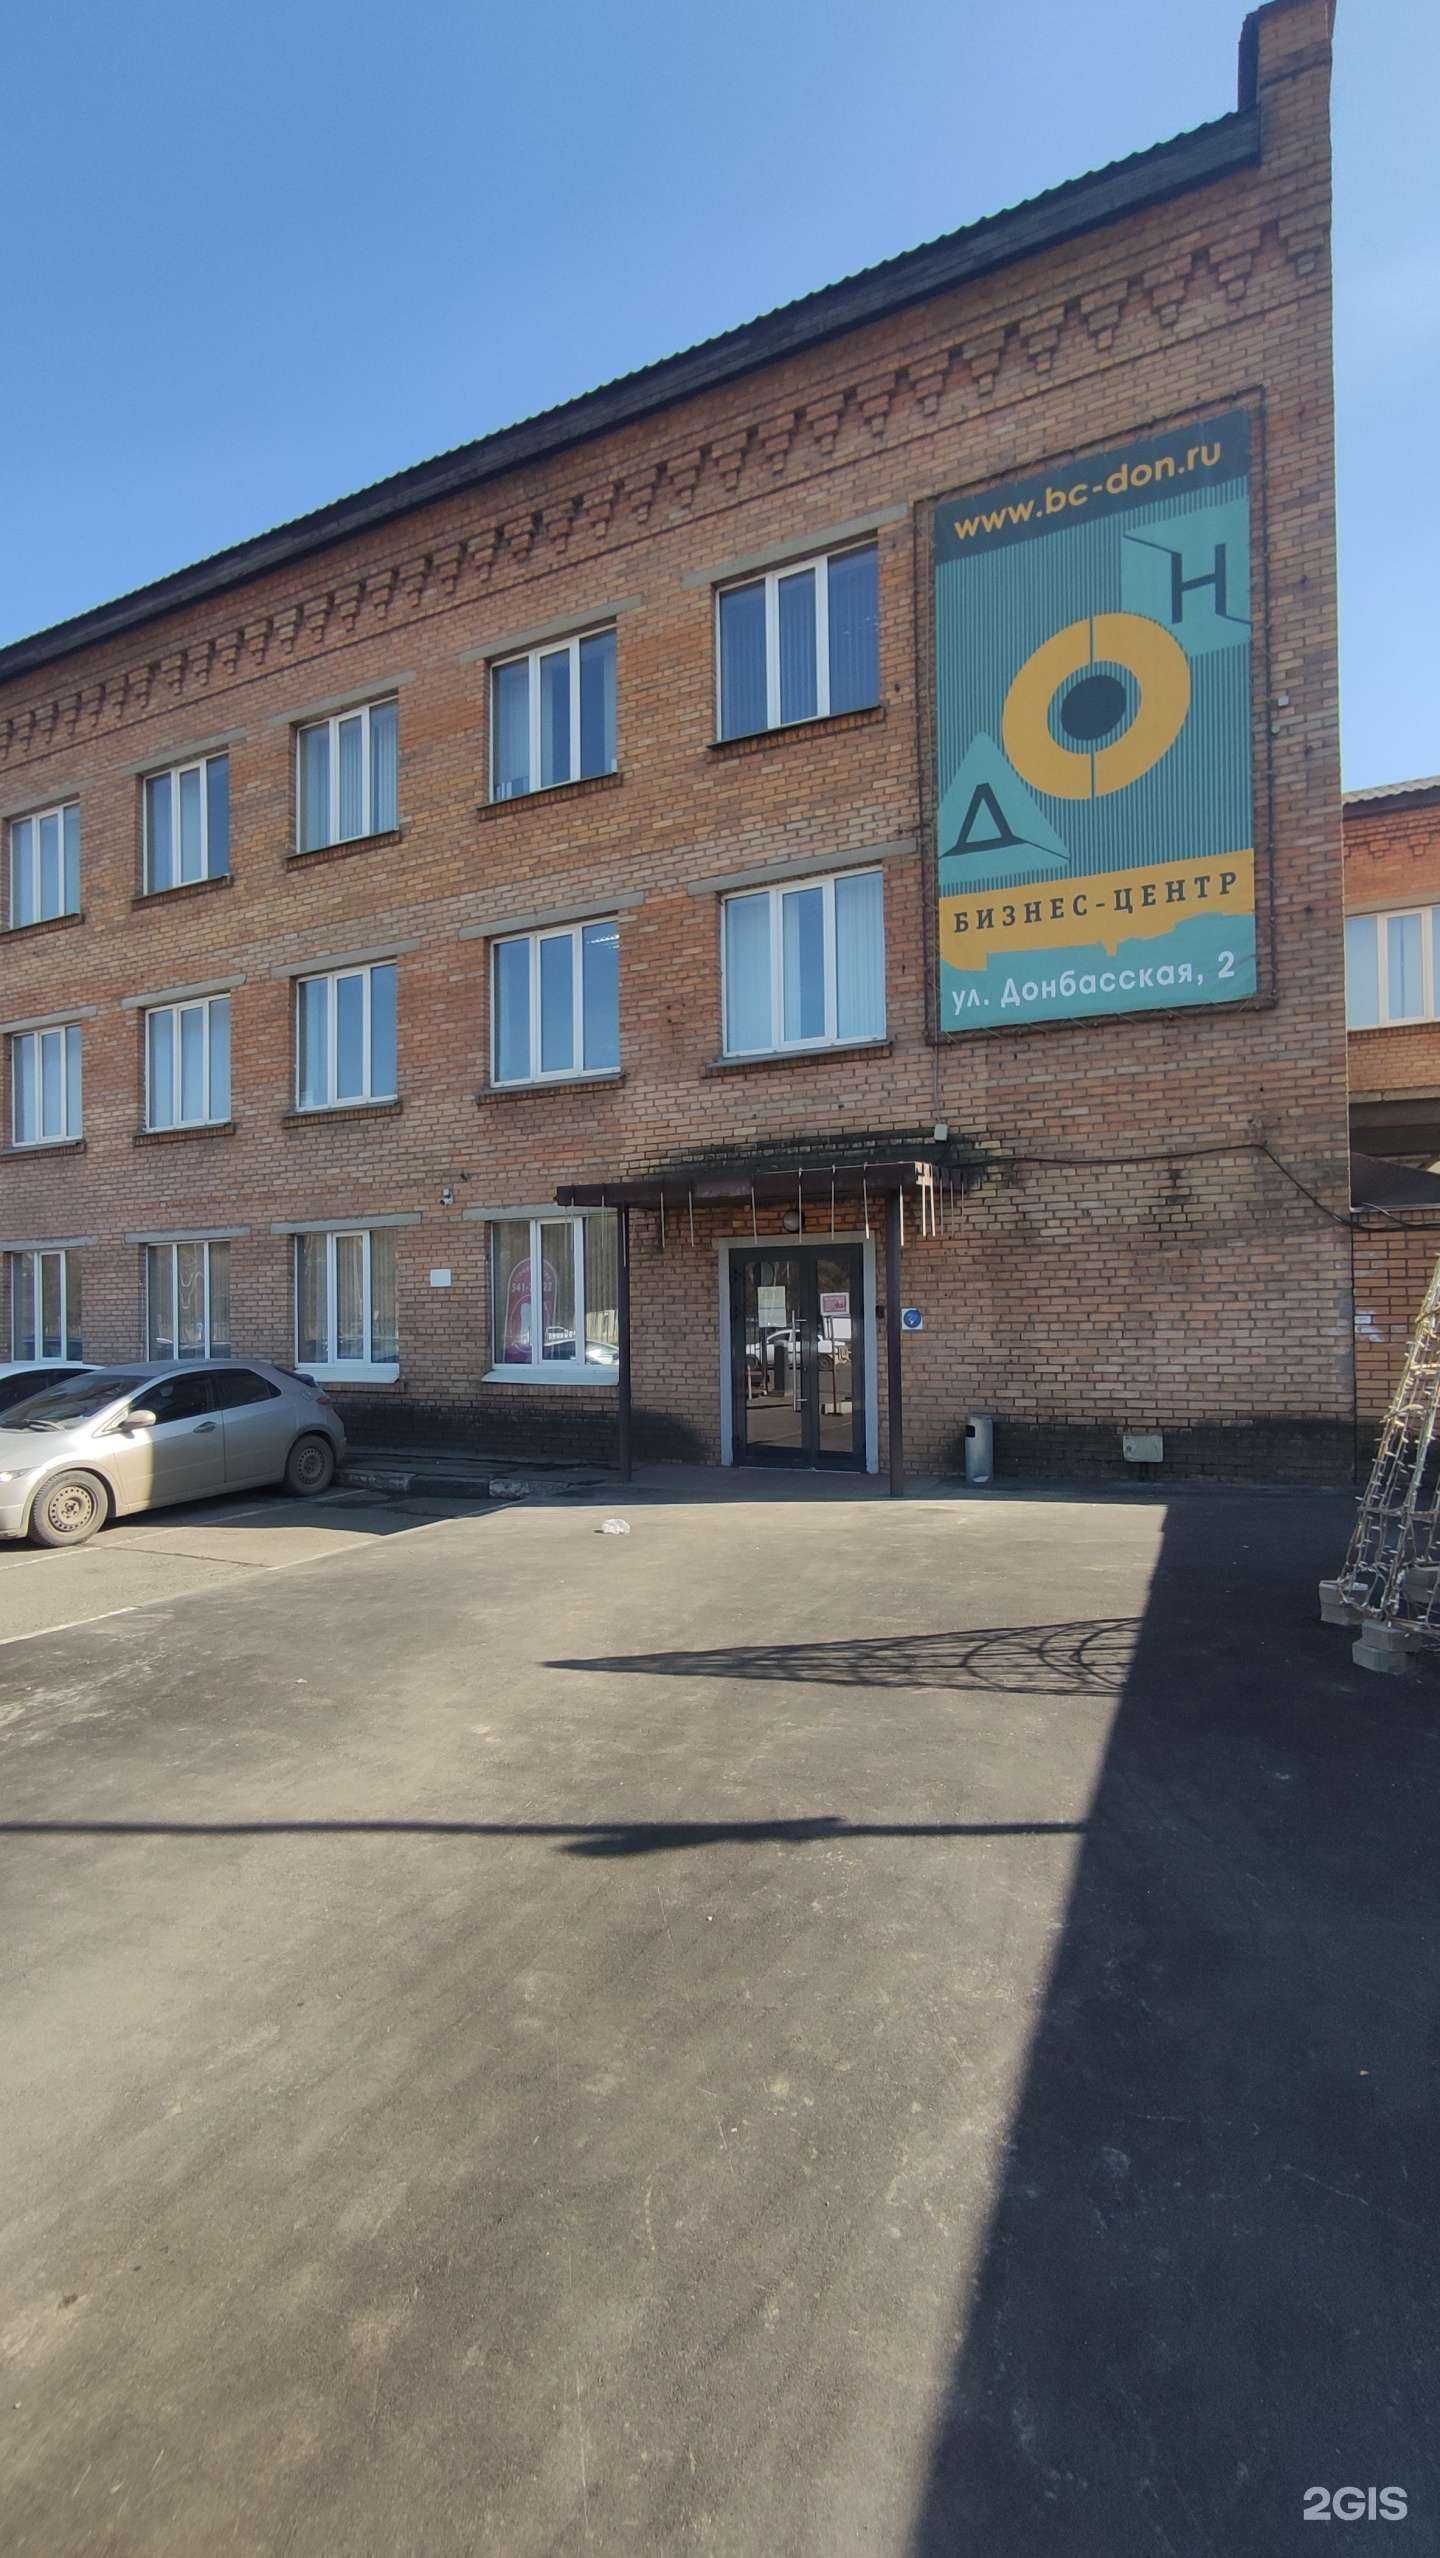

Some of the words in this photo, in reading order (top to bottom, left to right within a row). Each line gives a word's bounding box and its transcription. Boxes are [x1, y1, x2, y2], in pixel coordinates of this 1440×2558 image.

[954, 442, 1222, 540] www.bc-don.ru
[953, 871, 1238, 933] БИЗНЕС-ЦЕНТР
[952, 987, 990, 1015] ул.
[1000, 960, 1204, 1008] Донбасская,
[1216, 950, 1235, 979] 2
